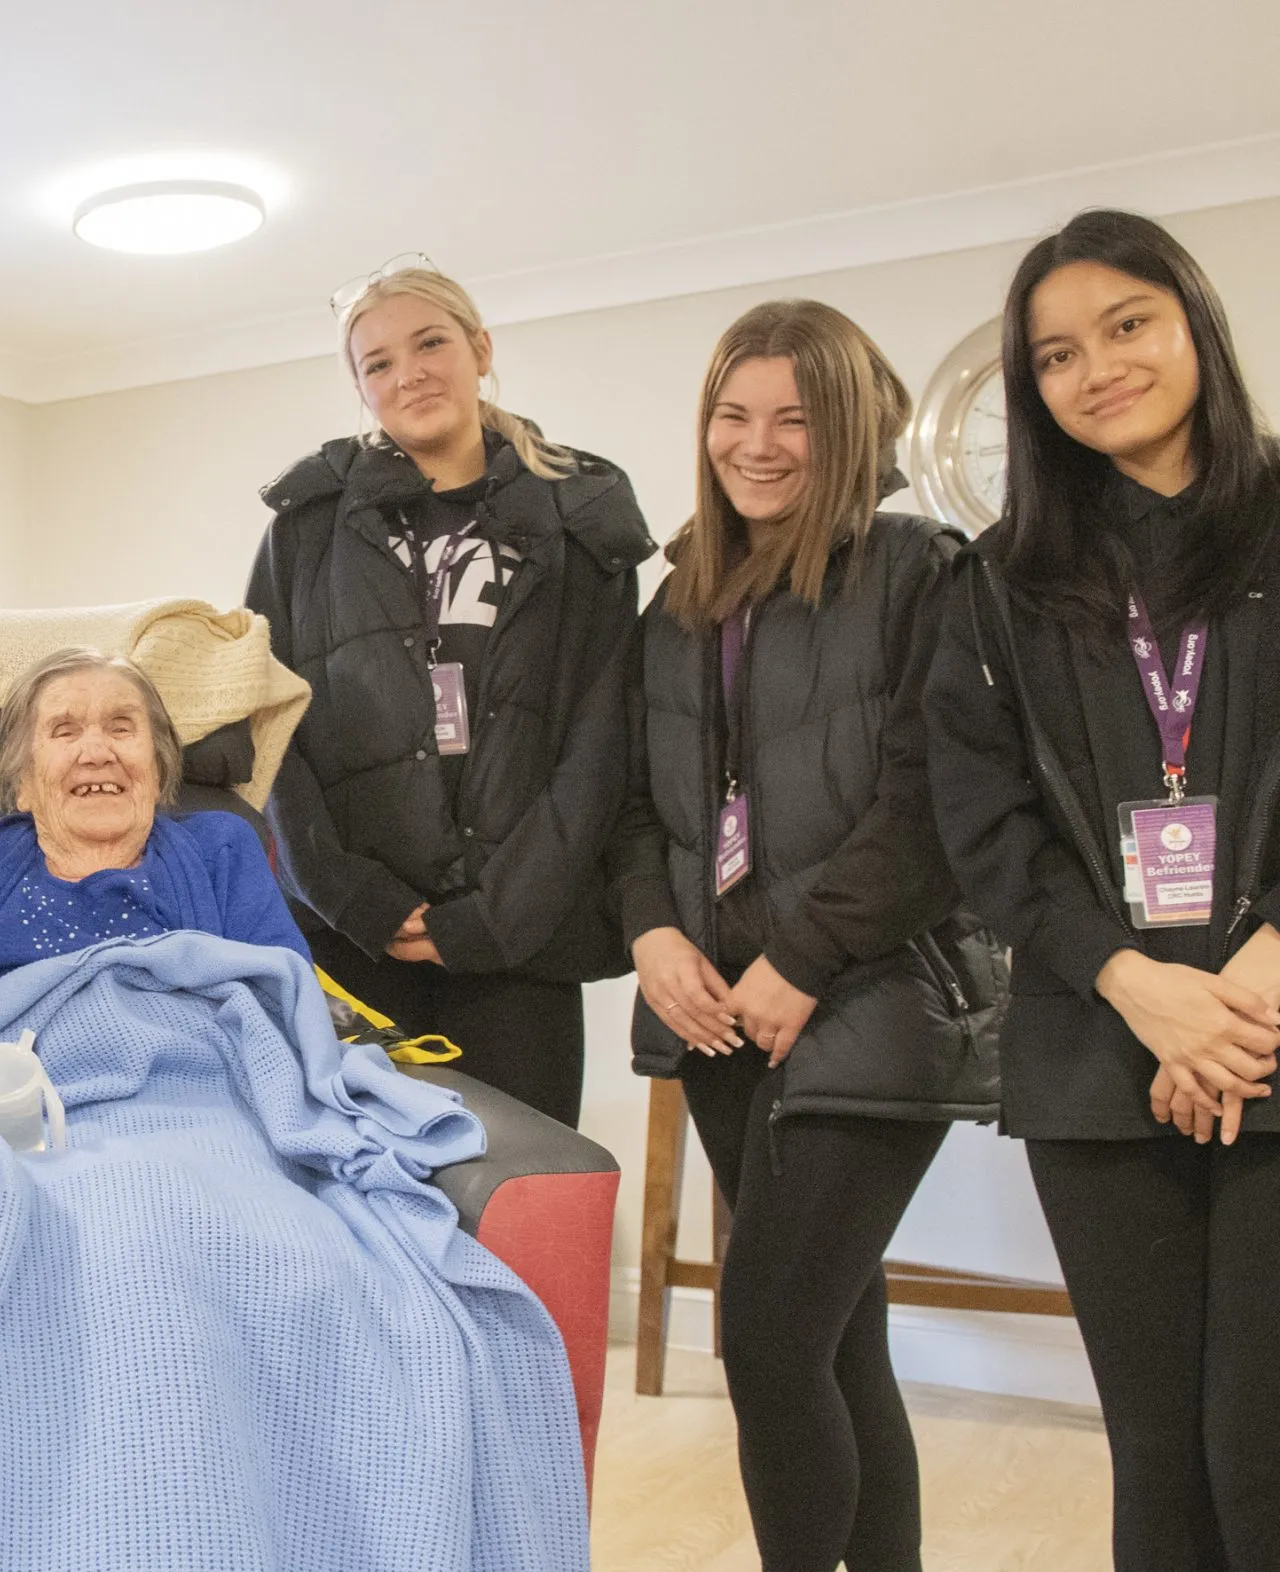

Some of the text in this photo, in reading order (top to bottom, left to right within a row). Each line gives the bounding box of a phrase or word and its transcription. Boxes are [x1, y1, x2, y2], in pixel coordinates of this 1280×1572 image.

[1182, 633, 1198, 676] yopey.org
[1148, 670, 1169, 711] yopey.org
[1159, 852, 1201, 864] YOPEY
